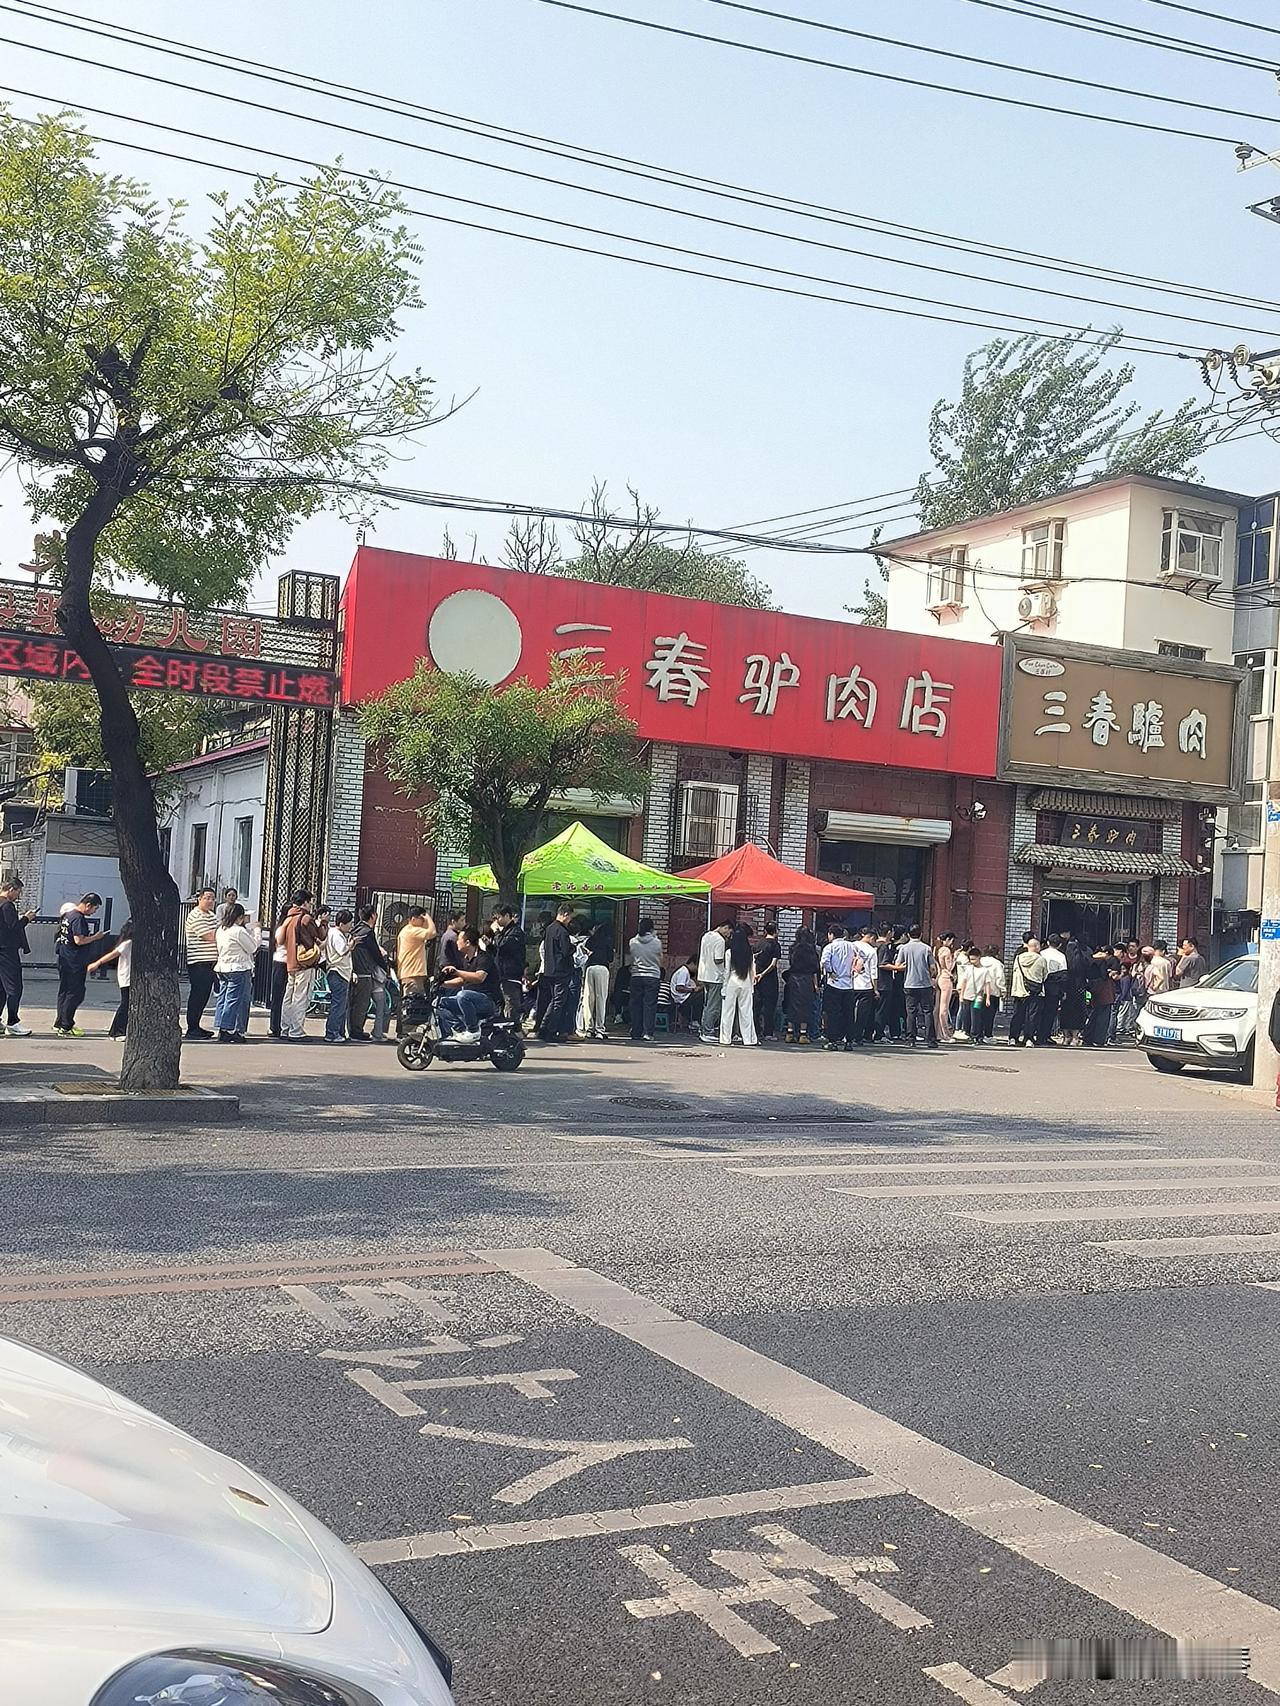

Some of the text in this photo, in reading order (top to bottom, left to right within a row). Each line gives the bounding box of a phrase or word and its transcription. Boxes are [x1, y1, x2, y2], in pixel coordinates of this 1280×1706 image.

[554, 621, 955, 738] 三春驴肉店
[1034, 689, 1208, 760] 三春驢肉
